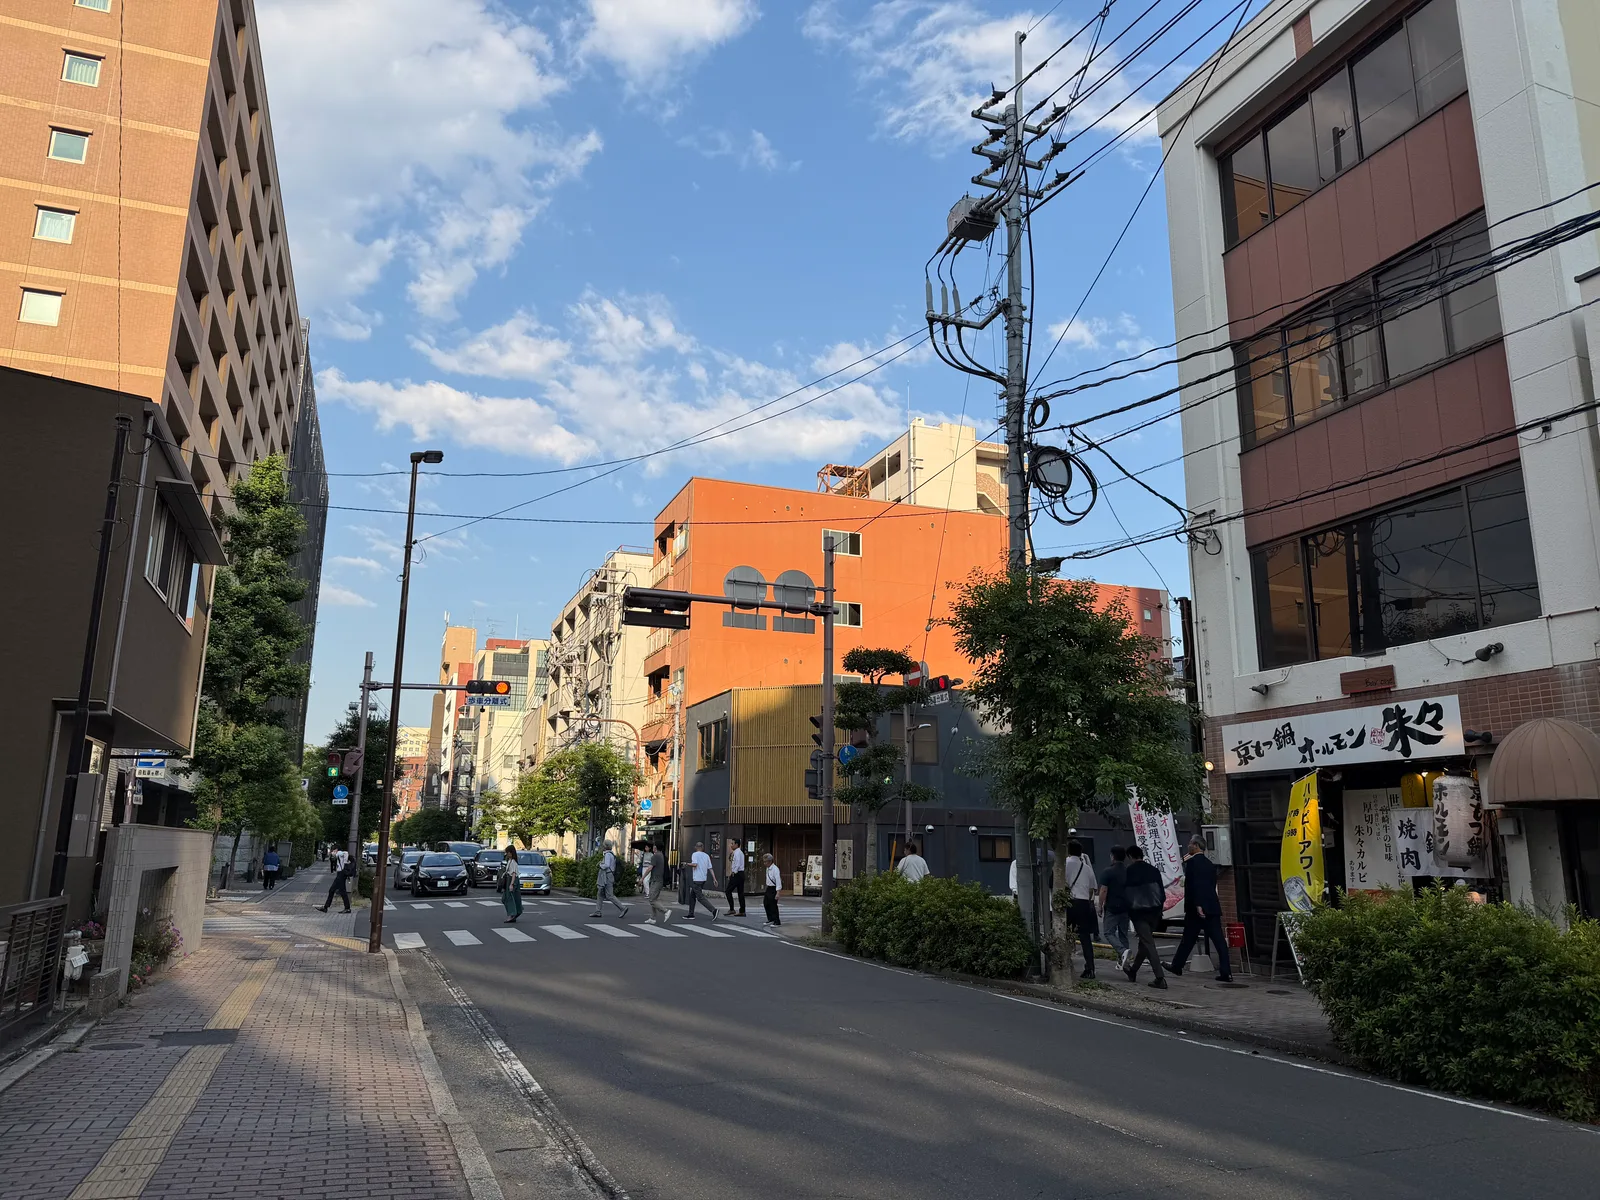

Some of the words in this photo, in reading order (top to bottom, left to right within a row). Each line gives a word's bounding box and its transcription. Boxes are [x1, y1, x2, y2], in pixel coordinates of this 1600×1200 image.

[468, 697, 508, 705] 歩車分離式
[1230, 722, 1297, 767] 京もつ鍋
[1298, 724, 1367, 764] ホルモン
[1380, 700, 1446, 758] 朱々
[1145, 809, 1167, 874] 総理大臣賞
[1298, 782, 1314, 886] ハッピーアワー
[1363, 802, 1374, 837] 厚切り
[1397, 817, 1422, 871] 焼肉
[1433, 783, 1450, 858] ホルモン
[1354, 824, 1368, 884] 朱々カルビ
